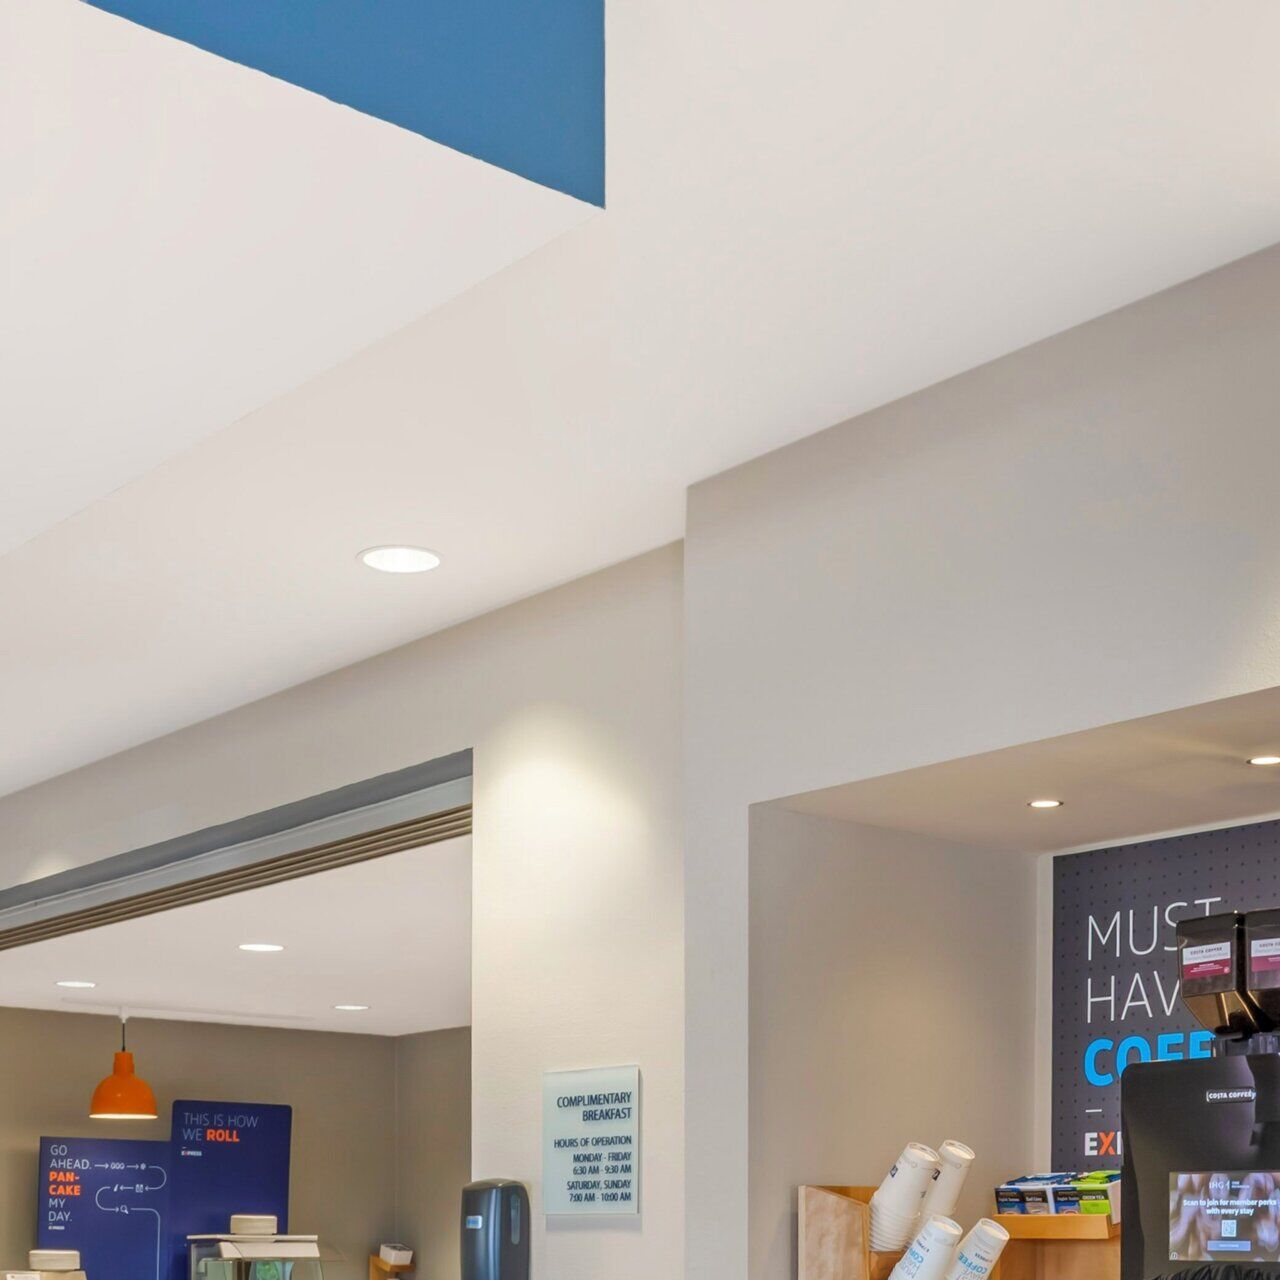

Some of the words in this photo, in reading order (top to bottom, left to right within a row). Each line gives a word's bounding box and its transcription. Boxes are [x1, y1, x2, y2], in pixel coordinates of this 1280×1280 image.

[1087, 970, 1180, 1024] HAV
[557, 1092, 632, 1108] COMPLIMENTARY
[1229, 1090, 1251, 1098] COFFEE
[184, 1112, 210, 1127] THIS
[213, 1113, 224, 1127] IS
[228, 1114, 259, 1128] HOW
[582, 1107, 632, 1121] BREAKFAST
[182, 1128, 202, 1141] WE
[206, 1129, 240, 1143] ROLL
[554, 1138, 579, 1148] HOURS
[580, 1137, 590, 1147] OF
[591, 1135, 632, 1146] OPERATION
[50, 1144, 68, 1156] GO
[573, 1153, 603, 1163] MONDAY
[607, 1151, 632, 1161] FRIDAY
[50, 1158, 92, 1170] AHEAD.
[572, 1165, 586, 1175] 6:30
[587, 1165, 600, 1175] AM
[604, 1165, 618, 1174] 9:30
[619, 1164, 632, 1173] AM
[49, 1171, 80, 1182] PAN-
[49, 1184, 81, 1196] CAKE
[567, 1180, 602, 1191] SATURDAY,
[604, 1179, 632, 1189] SUNDAY
[569, 1193, 583, 1202] 7:00
[584, 1192, 595, 1202] AM
[601, 1192, 618, 1202] 10:00
[619, 1191, 632, 1201] AM
[49, 1198, 66, 1208] MY
[1207, 1199, 1218, 1208] join
[1258, 1199, 1277, 1208] perks
[48, 1210, 73, 1222] DAY.
[1221, 1208, 1239, 1216] every
[1240, 1208, 1255, 1216] stay
